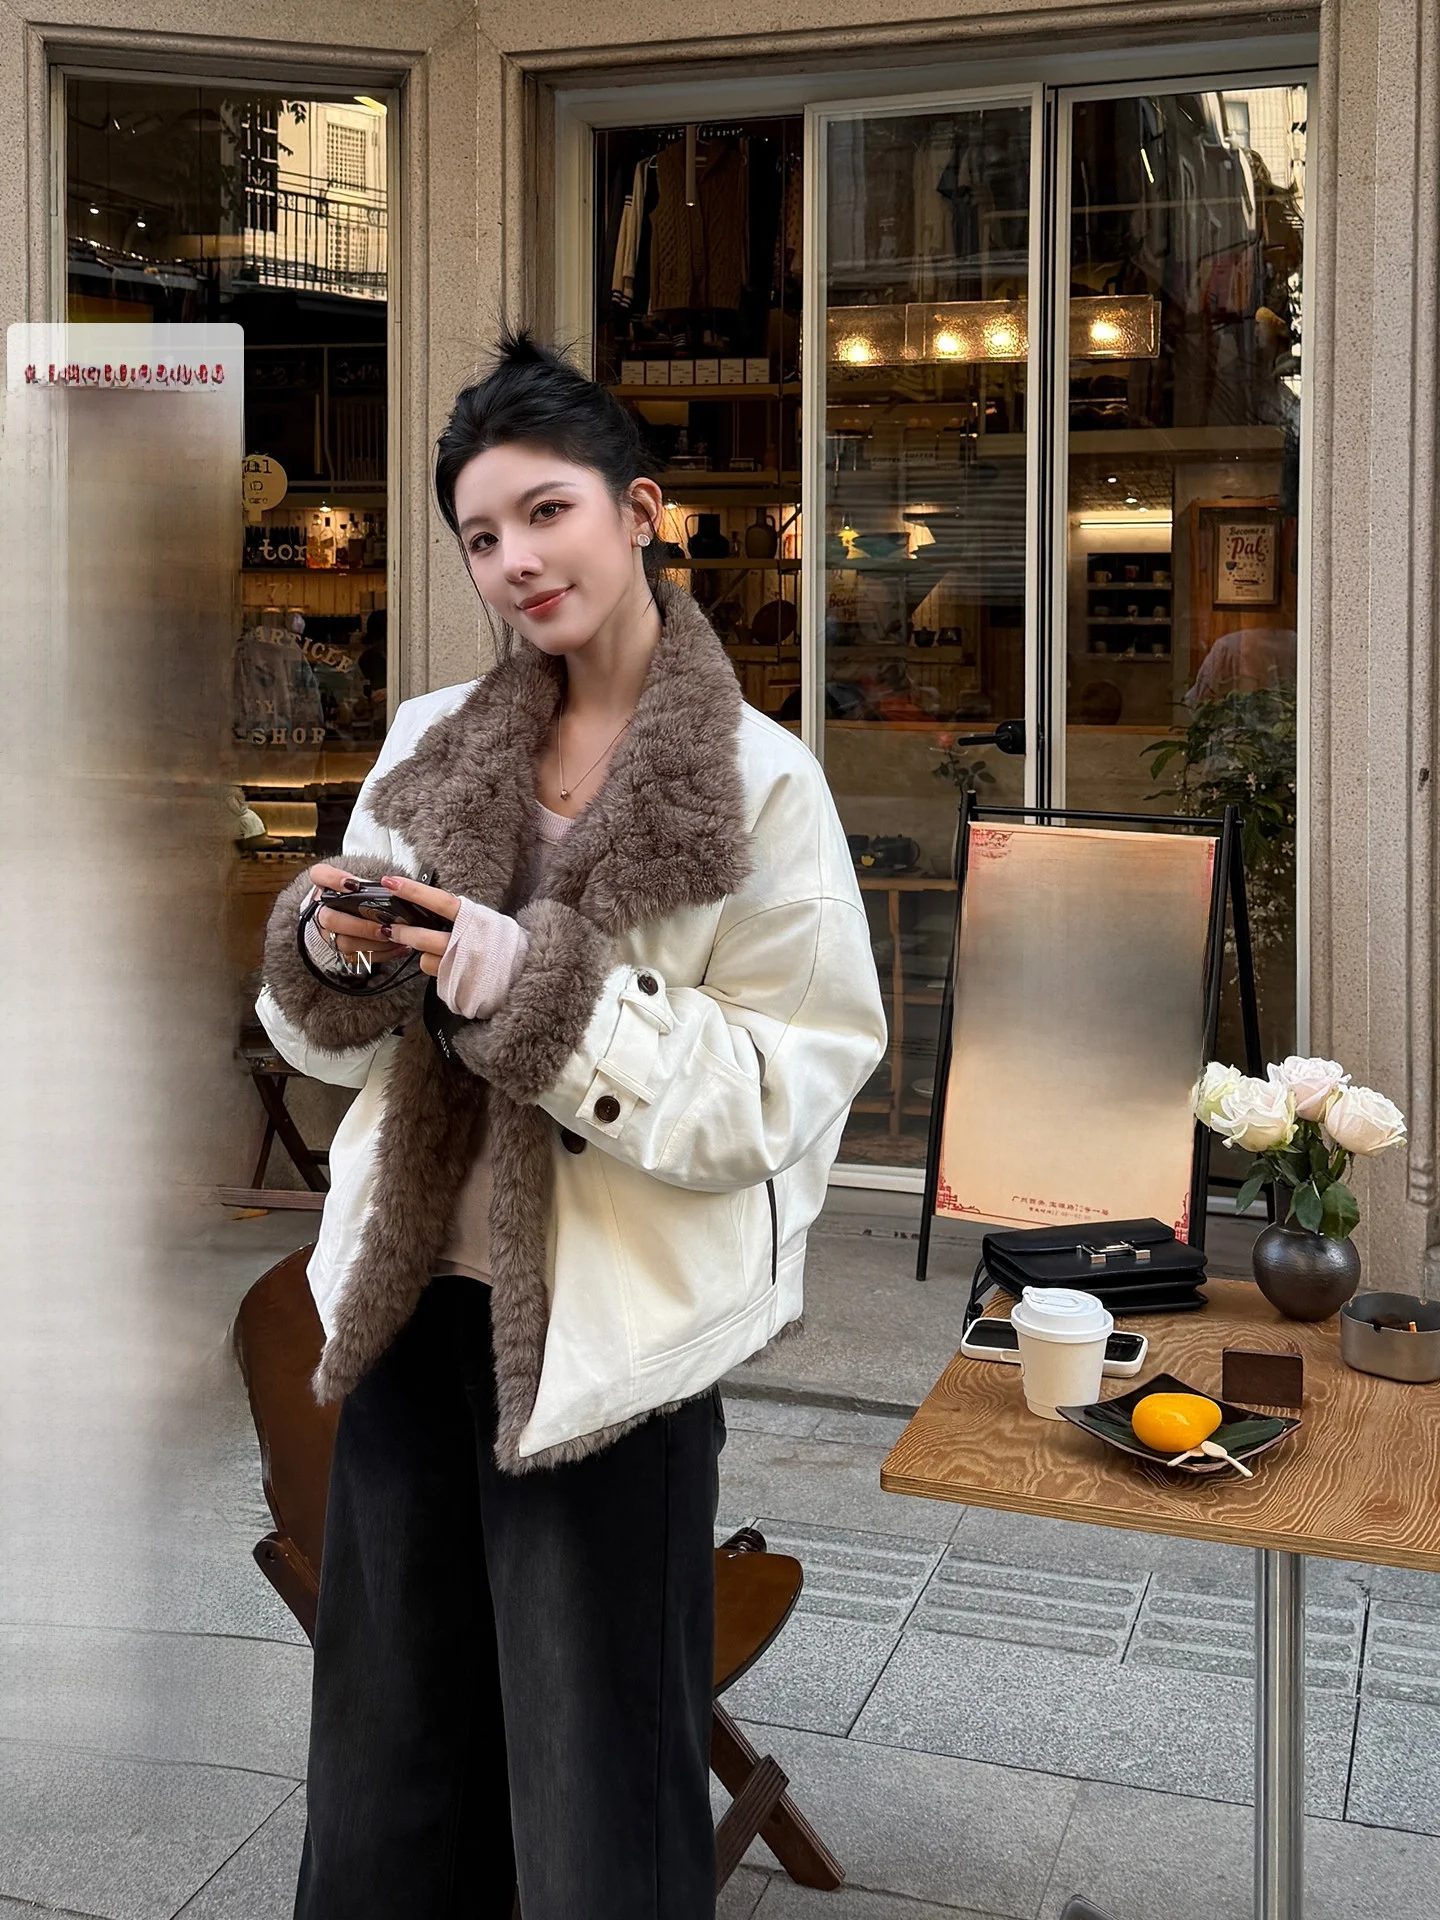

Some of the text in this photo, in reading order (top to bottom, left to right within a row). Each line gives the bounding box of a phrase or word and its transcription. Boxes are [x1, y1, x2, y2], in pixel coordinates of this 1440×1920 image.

[1230, 527, 1259, 535] Become
[1231, 536, 1266, 562] Pal
[255, 625, 354, 674] ARTICLE
